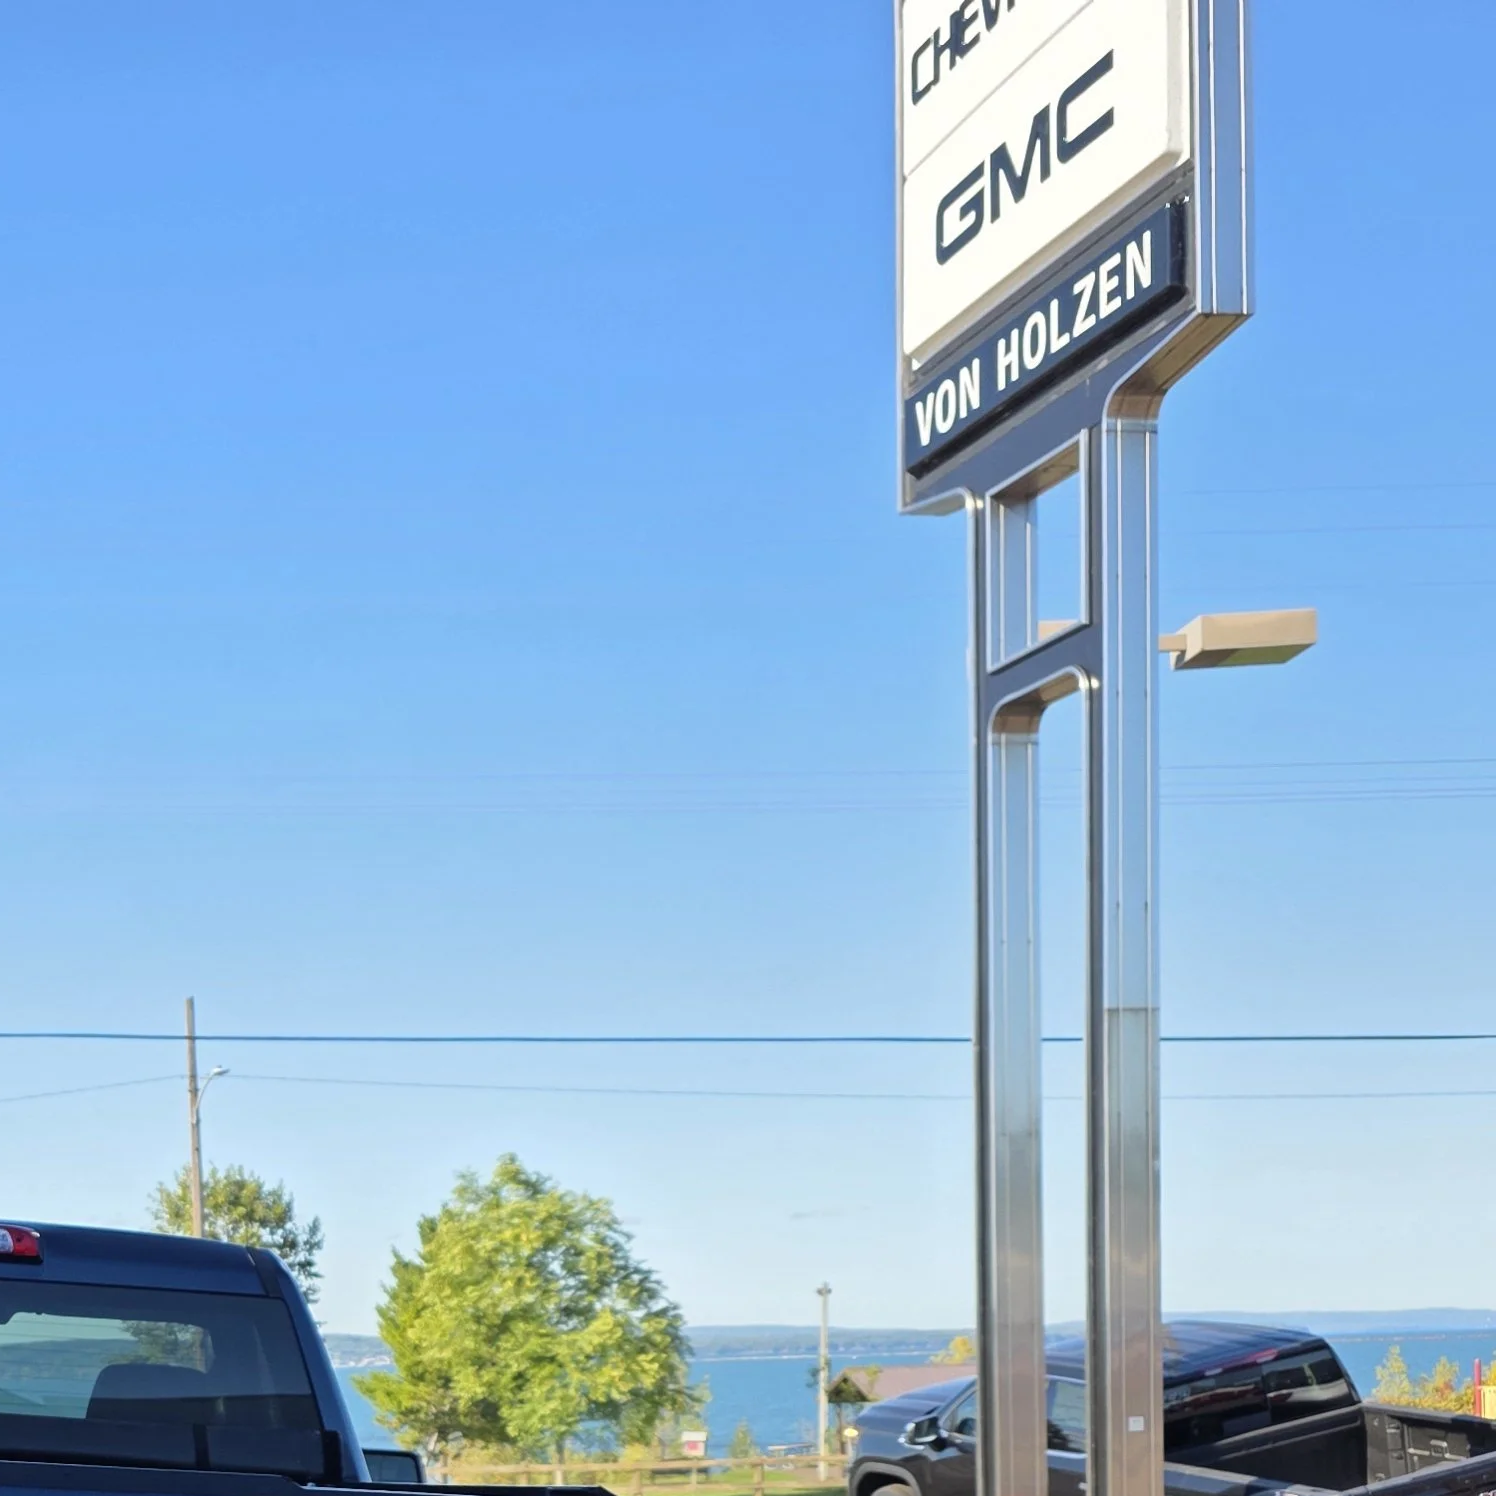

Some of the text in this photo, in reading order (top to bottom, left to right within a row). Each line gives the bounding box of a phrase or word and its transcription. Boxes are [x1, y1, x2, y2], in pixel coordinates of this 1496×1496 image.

[912, 0, 1015, 105] CHEV
[936, 49, 1114, 265] GMC
[914, 230, 1153, 447] VON HOLZEN
